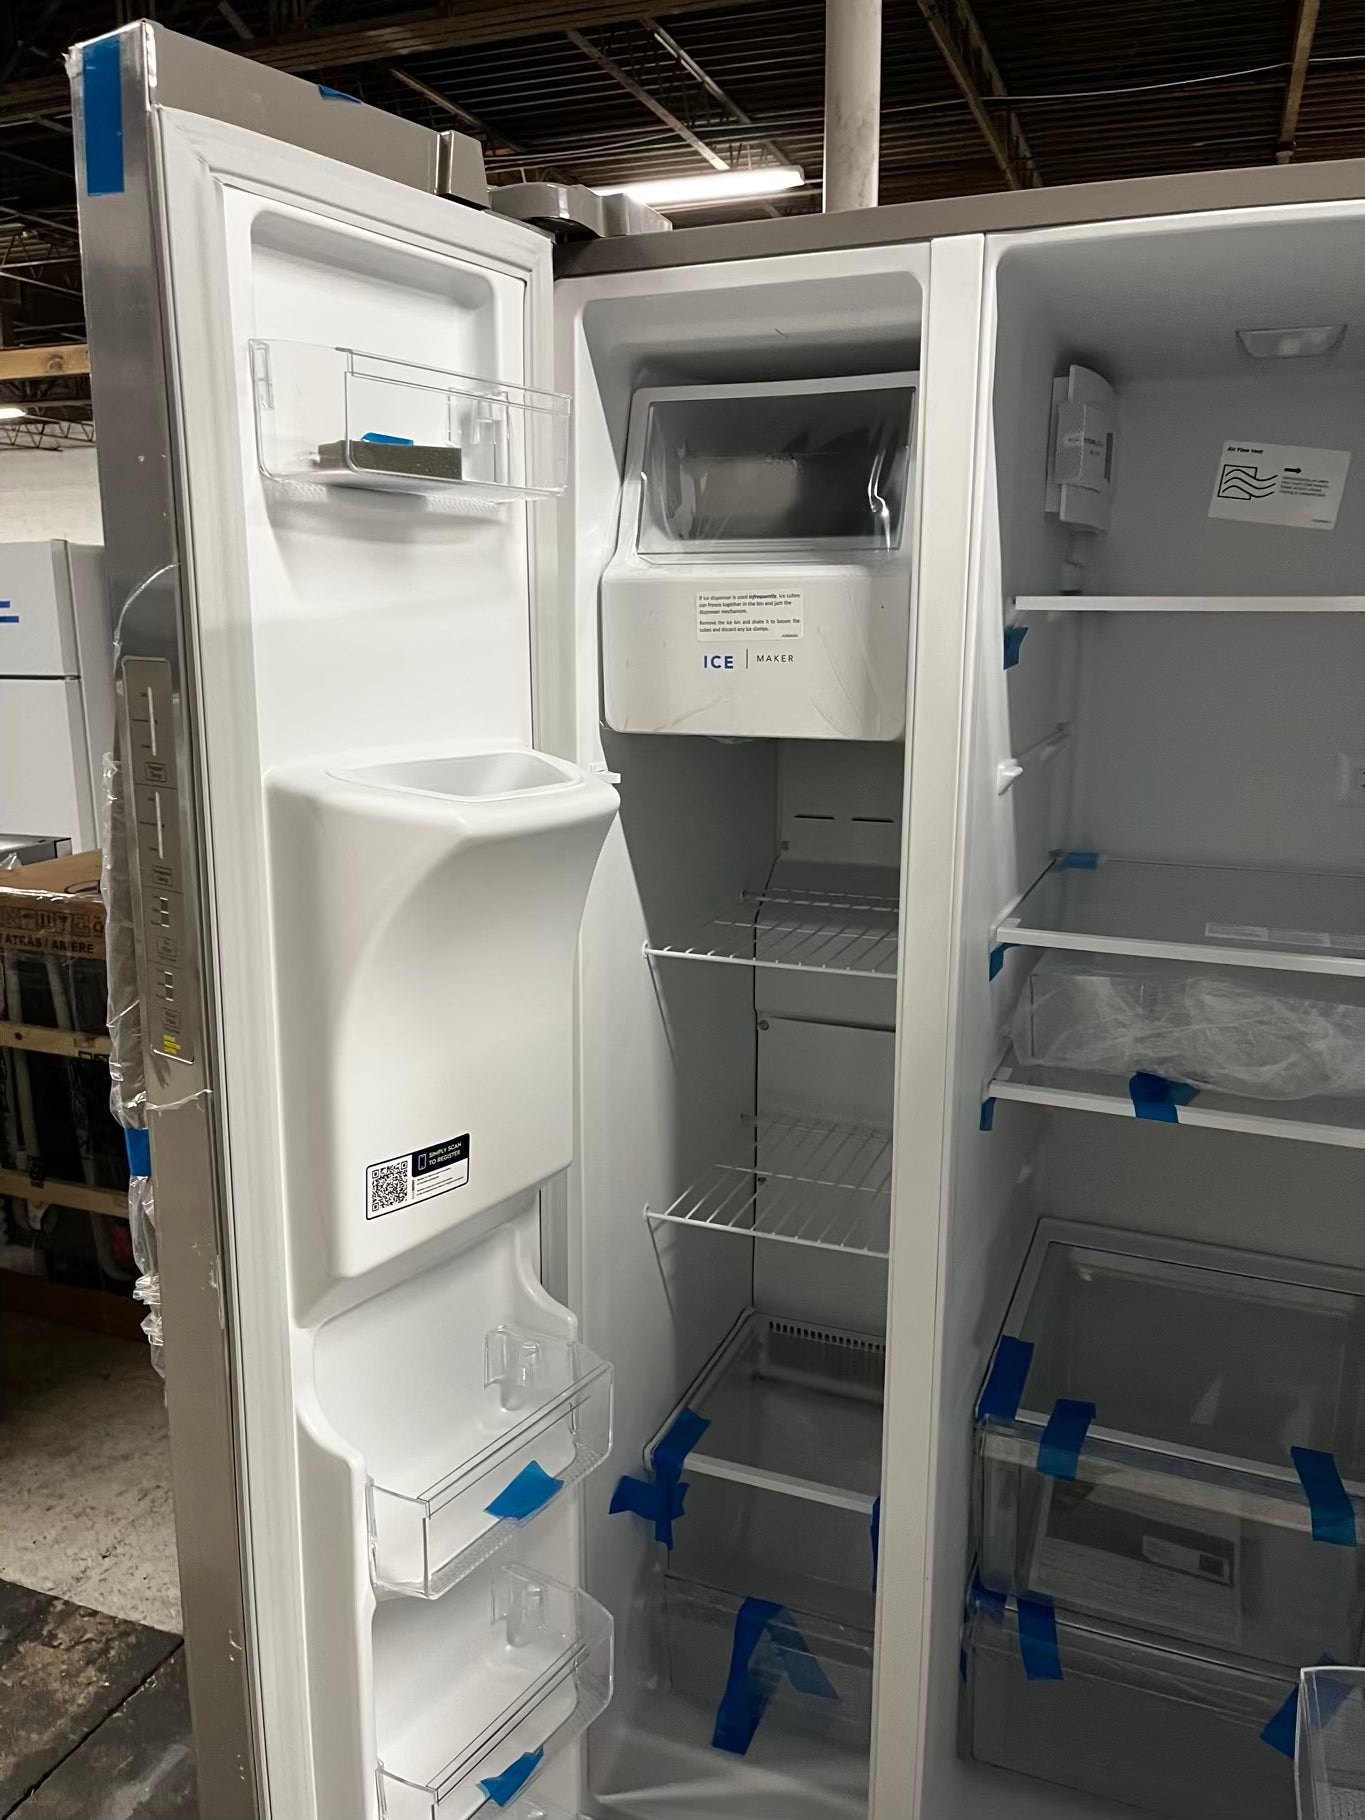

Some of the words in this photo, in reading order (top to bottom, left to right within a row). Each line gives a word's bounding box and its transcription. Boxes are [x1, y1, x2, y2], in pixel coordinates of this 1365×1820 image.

[704, 655, 734, 669] ICE
[756, 654, 794, 662] MAKER
[428, 1147, 447, 1158] SIMPLY
[448, 1142, 462, 1152] SCAN
[437, 1150, 461, 1162] REGISTER
